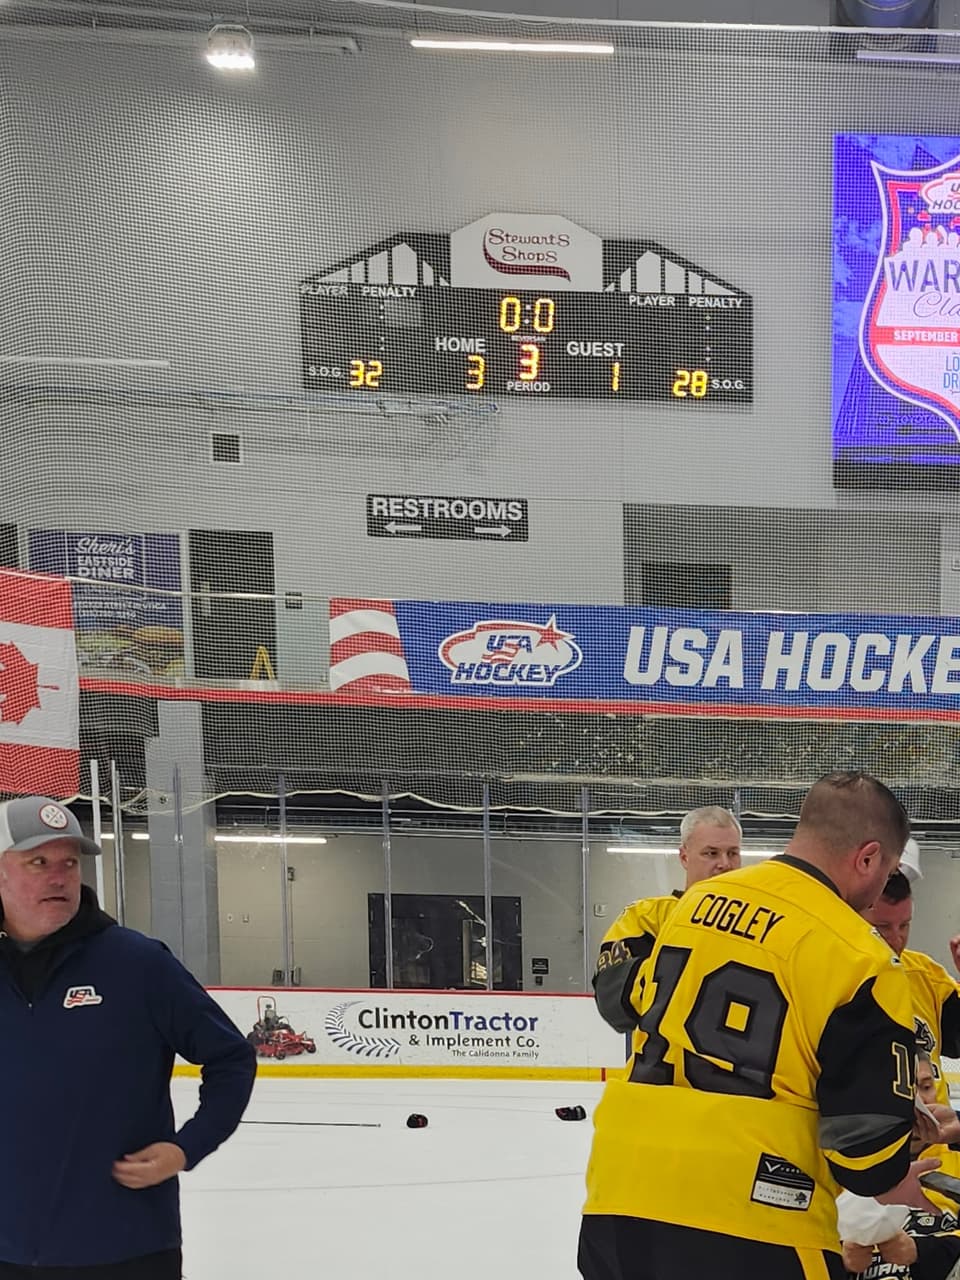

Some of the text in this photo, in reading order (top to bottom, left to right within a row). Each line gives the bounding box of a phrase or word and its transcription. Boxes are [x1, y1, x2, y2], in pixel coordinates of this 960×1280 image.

[301, 286, 417, 298] PLAYER PENALTY
[629, 295, 742, 308] PLAYER PENALTY
[435, 337, 486, 352] HOME
[893, 330, 958, 342] SEPTEMBER
[566, 341, 625, 357] GUEST
[519, 344, 540, 380] 3
[308, 366, 345, 378] S.O.G.
[350, 360, 383, 387] 32
[466, 355, 486, 389] 3
[612, 362, 620, 391] 1
[507, 381, 551, 392] PERIOD
[672, 370, 708, 397] 28
[711, 379, 746, 389] S.O.G.
[372, 498, 522, 522] RESTROOMS
[78, 556, 134, 567] EASTSIDE
[78, 567, 135, 579] DINER
[486, 633, 532, 653] USA
[622, 625, 744, 689] USA
[454, 662, 562, 683] HOCKEY
[690, 893, 786, 944] COGLEY
[627, 945, 789, 1100] 19
[408, 1034, 540, 1050] & Implement Co.
[452, 1049, 467, 1057] The
[512, 1050, 539, 1059] Family
[891, 1041, 914, 1100] 1
